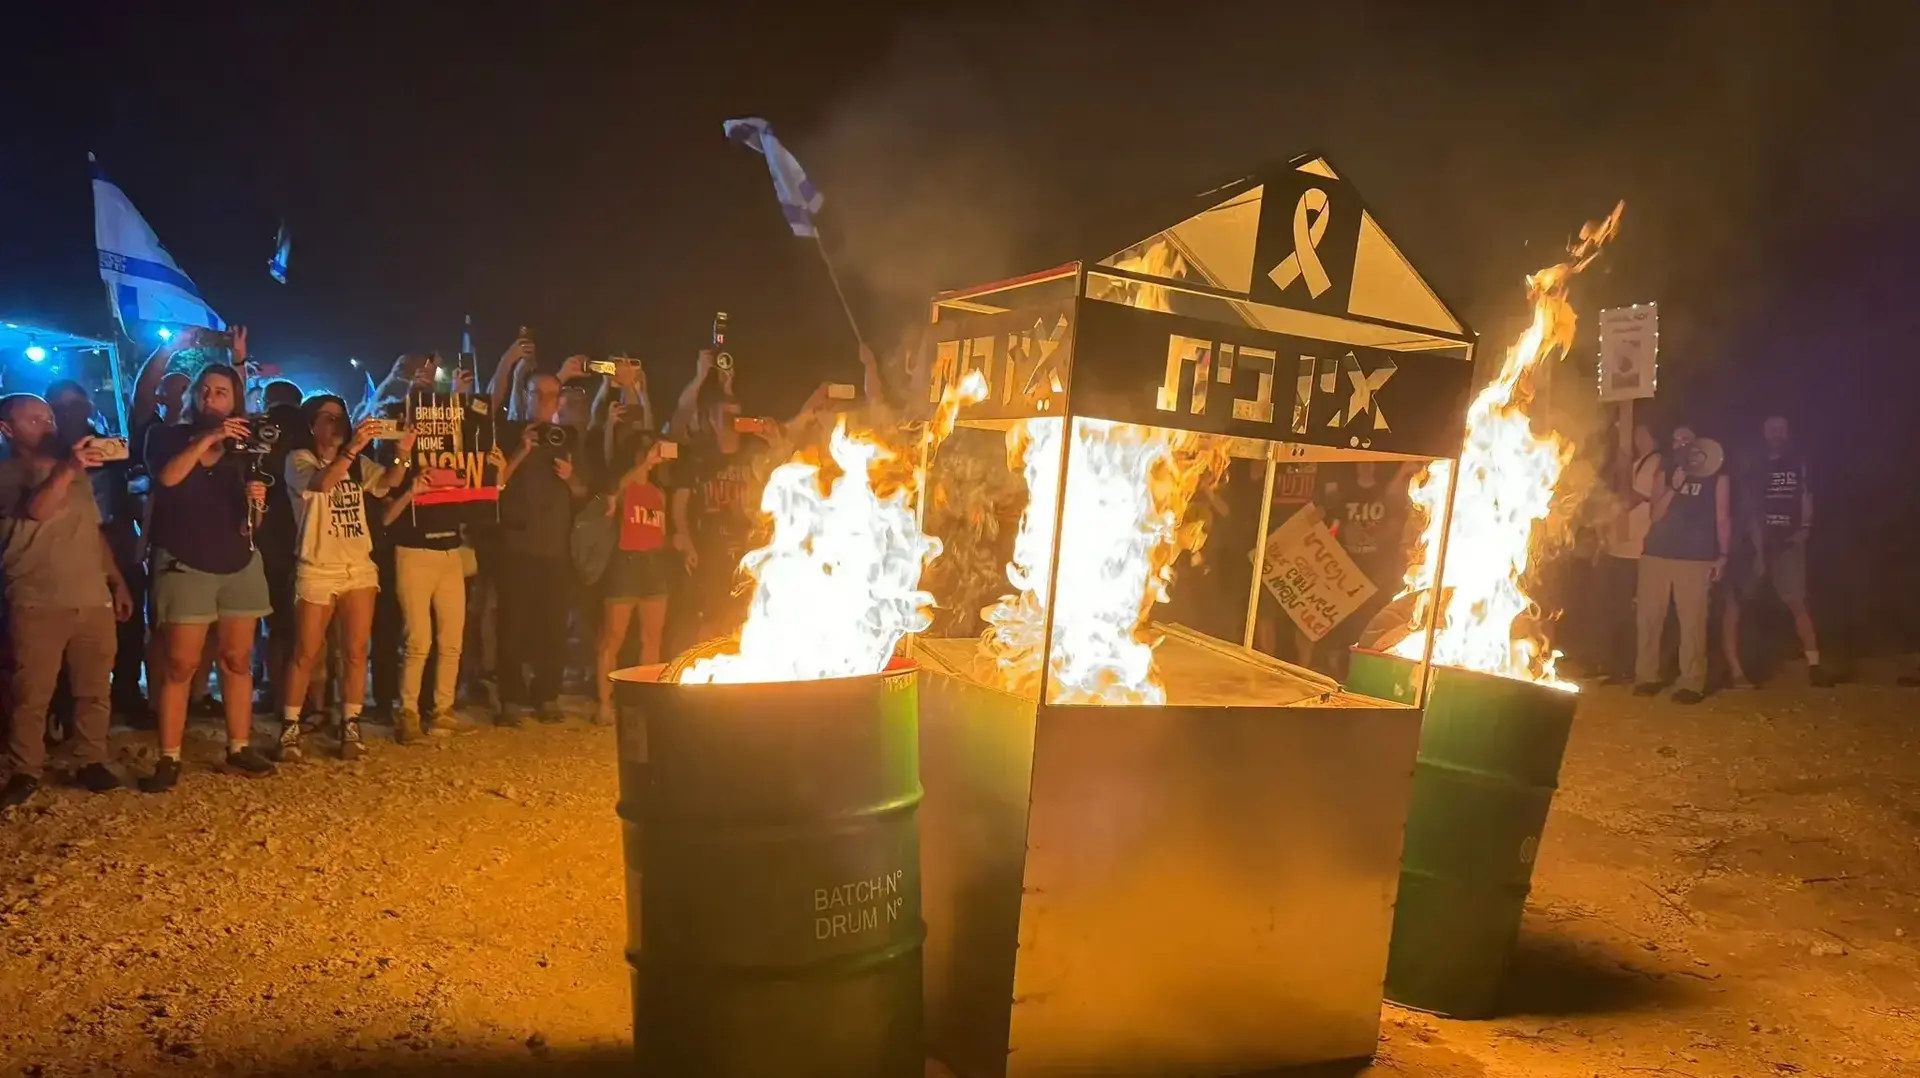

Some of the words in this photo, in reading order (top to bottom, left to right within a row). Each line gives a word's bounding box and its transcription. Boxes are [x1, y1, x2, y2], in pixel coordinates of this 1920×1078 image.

[1156, 334, 1276, 424] בית
[415, 406, 444, 420] BRING
[445, 406, 465, 420] OUR
[416, 421, 455, 435] SISTERS
[417, 437, 444, 450] HOME
[1345, 501, 1386, 520] 7.10
[814, 876, 882, 911] BATCH
[815, 906, 878, 940] DRUM
